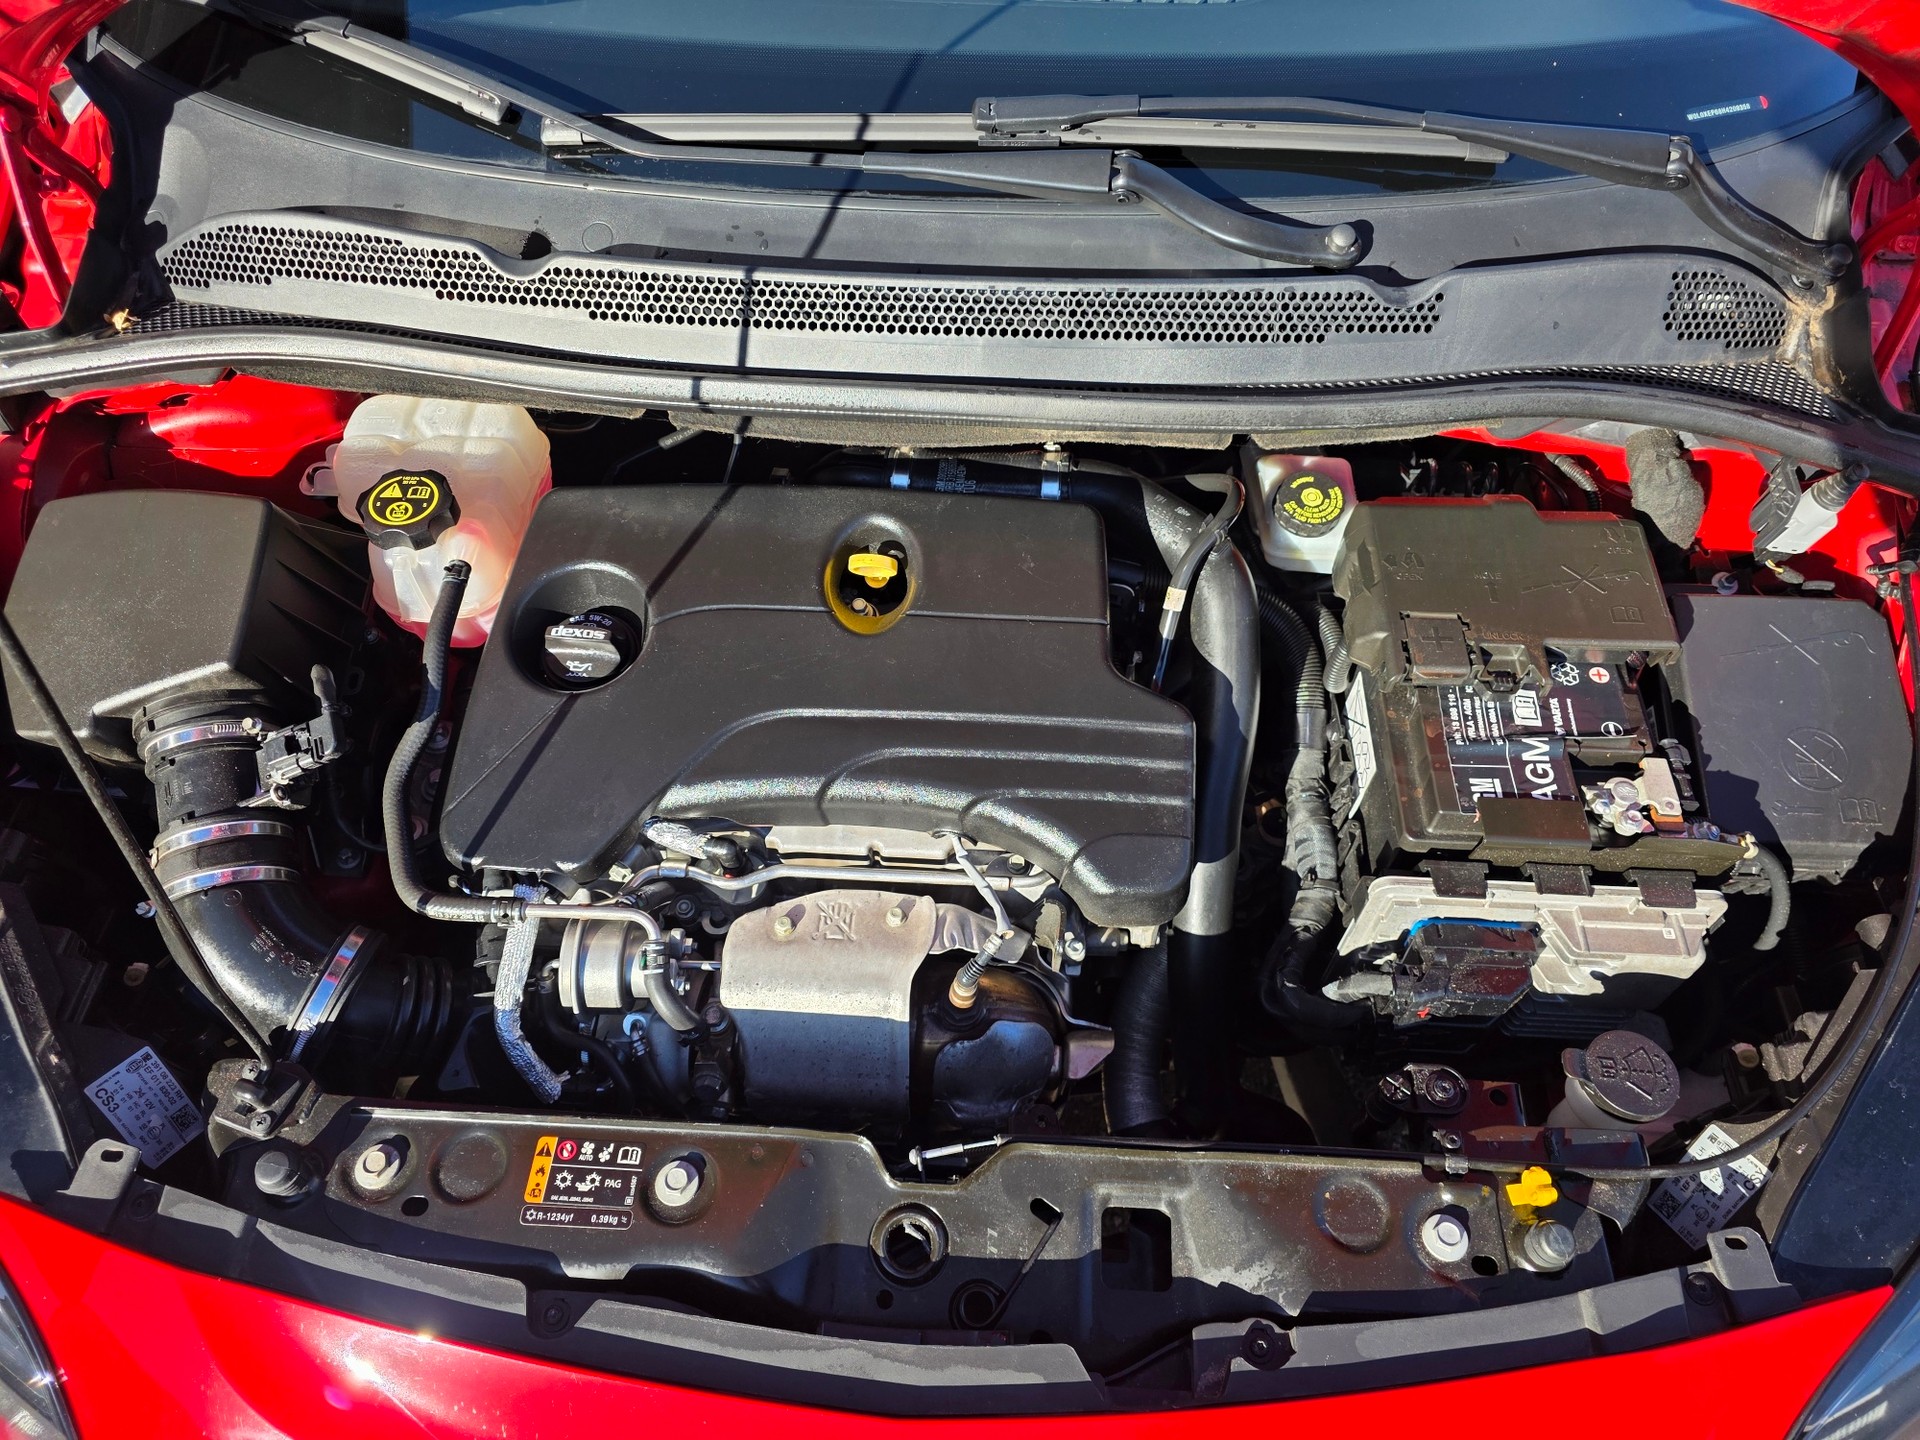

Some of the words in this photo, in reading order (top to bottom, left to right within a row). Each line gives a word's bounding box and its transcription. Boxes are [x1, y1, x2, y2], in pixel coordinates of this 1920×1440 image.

[1396, 572, 1424, 581] OPEN
[1474, 572, 1502, 580] MOVE
[569, 614, 586, 624] SAE
[551, 625, 608, 640] dexos
[1482, 631, 1525, 641] UNLOCK
[1550, 698, 1562, 726] VARTA
[1522, 737, 1558, 801] AGM
[142, 1063, 153, 1075] 1EF
[150, 1074, 161, 1086] 011
[151, 1060, 161, 1071] 391
[159, 1070, 168, 1079] 08
[166, 1079, 176, 1090] 223
[174, 1090, 184, 1100] RH
[95, 1088, 120, 1113] CS3
[143, 1098, 154, 1110] 12V
[1696, 1146, 1705, 1156] LH
[604, 1179, 622, 1188] PAG
[1709, 1172, 1720, 1183] 12V
[1744, 1168, 1766, 1191] CSY
[1679, 1180, 1691, 1192] 1EF
[537, 1212, 574, 1222] R-1234yf
